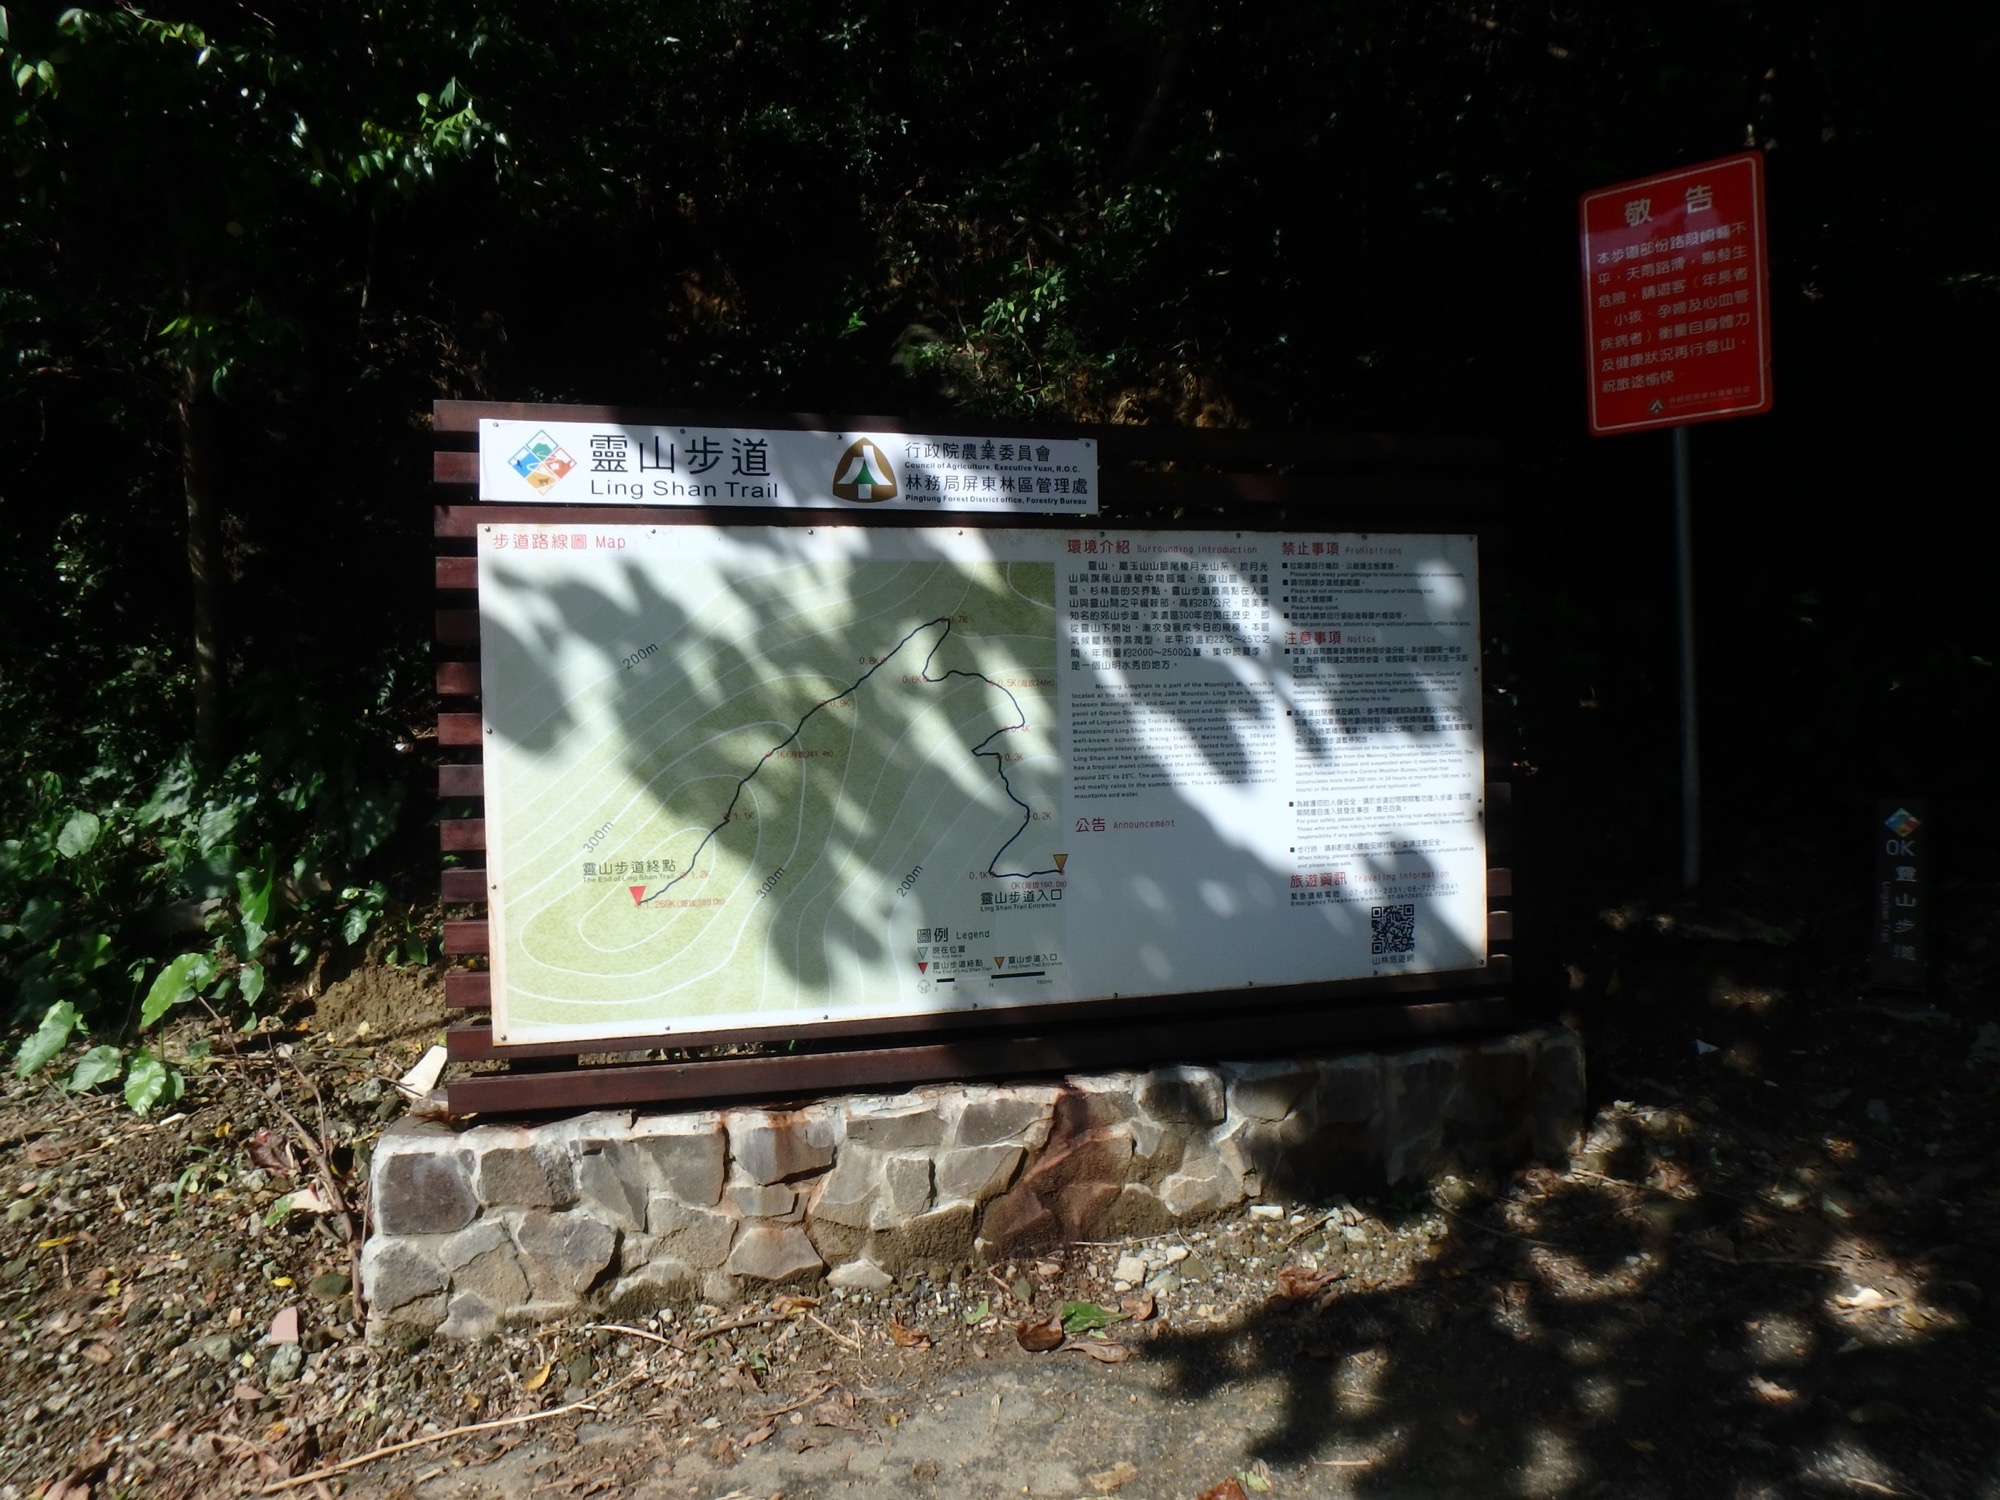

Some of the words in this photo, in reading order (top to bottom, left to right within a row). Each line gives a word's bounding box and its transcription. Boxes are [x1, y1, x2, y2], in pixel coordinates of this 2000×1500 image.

[1625, 185, 1713, 228] 敬告
[590, 434, 772, 478] 靈山步道
[905, 441, 1051, 462] 行政院農業委員會
[1033, 465, 1054, 473] Yuan,
[591, 480, 643, 499] Ling
[653, 481, 715, 498] Shan
[721, 482, 778, 499] Trail
[906, 474, 1088, 495] 林務局屏東林區管理處
[906, 495, 941, 503] Pingtung
[493, 533, 588, 551] 步道路線圖
[596, 535, 626, 551] Map
[1067, 539, 1130, 555] 環境介紹
[1137, 545, 1193, 555] Surrounding
[1198, 545, 1258, 554] Introduction
[1282, 542, 1340, 556] 禁止事項
[1345, 547, 1402, 555] Prohibitions
[1284, 631, 1341, 646] 注意事項
[622, 642, 660, 670] 200m
[1075, 817, 1106, 833] 公告
[1113, 819, 1175, 830] Announcement
[582, 820, 615, 854] 300m
[1886, 839, 1915, 857] OK
[583, 859, 676, 876] 靈山步道終點
[757, 866, 785, 900] 300m
[896, 864, 924, 897] 200m
[1290, 871, 1347, 889] 旅遊資訊
[981, 889, 1063, 905] 靈山步道入口
[1894, 866, 1918, 962] 靈山步道
[917, 927, 949, 943] 圖例
[956, 930, 990, 941] Legend
[932, 945, 966, 954] 現在位置
[1008, 953, 1058, 964] 靈山步道入口
[933, 959, 983, 970] 靈山步道終點
